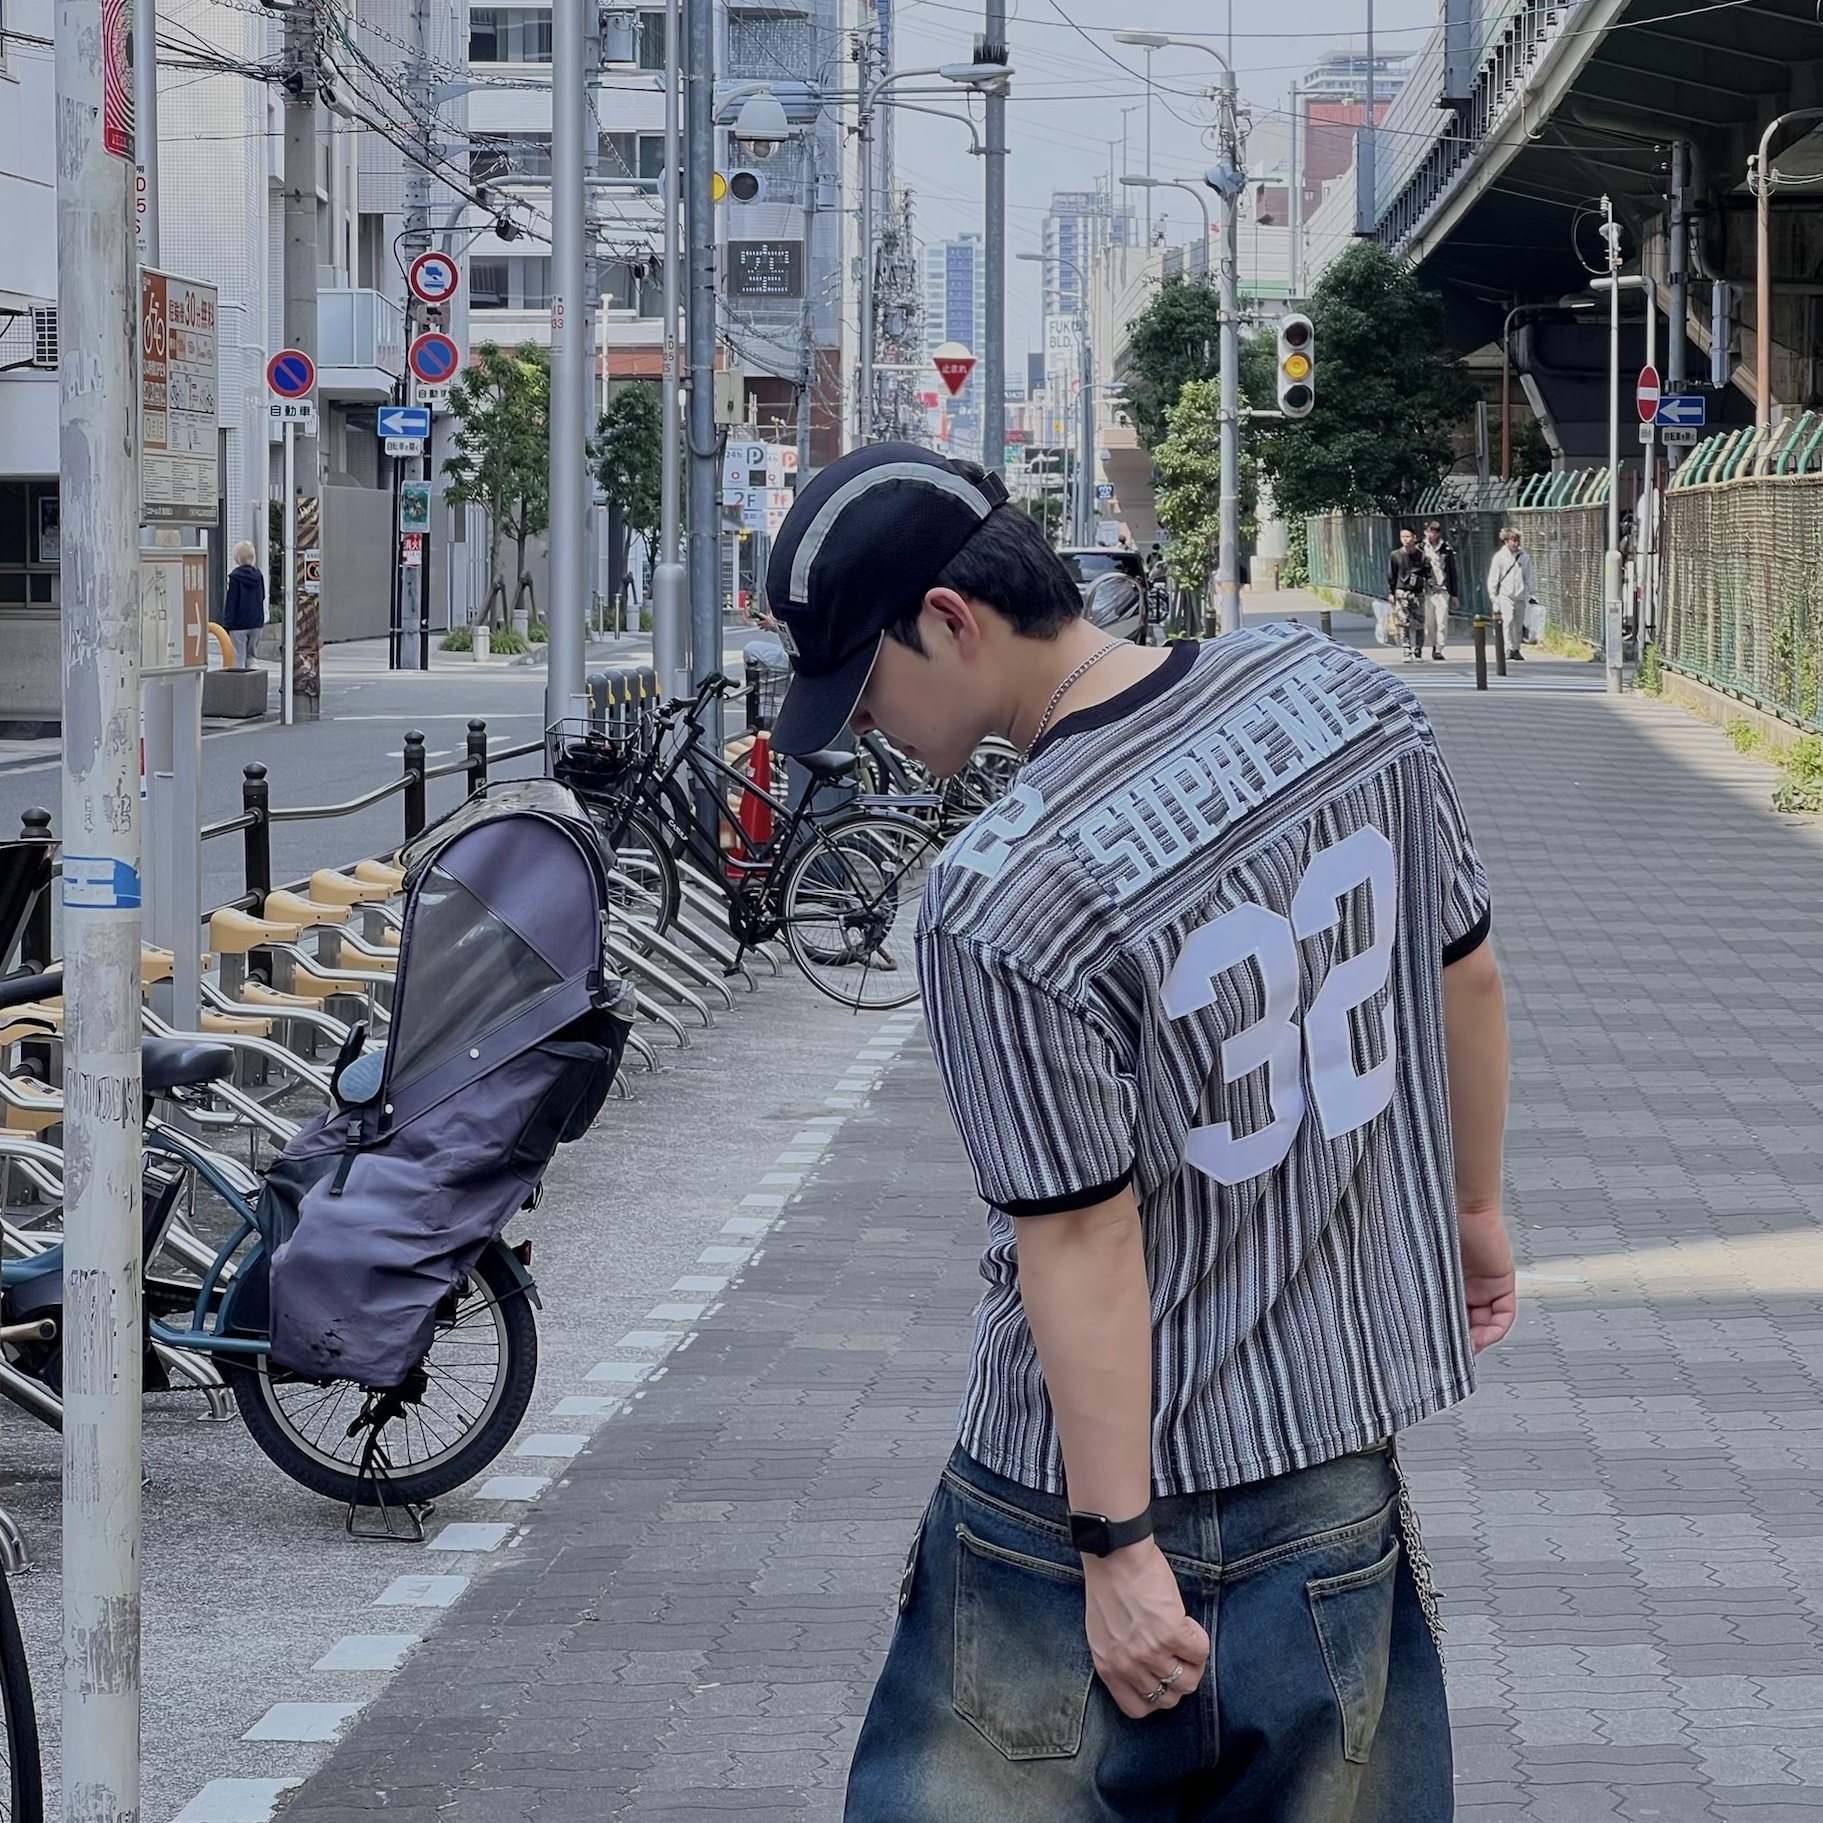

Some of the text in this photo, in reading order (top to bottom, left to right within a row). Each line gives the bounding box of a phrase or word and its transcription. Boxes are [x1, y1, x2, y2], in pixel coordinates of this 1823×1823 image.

[740, 244, 790, 292] 空
[941, 364, 968, 375] 止まれ
[270, 405, 311, 417] 自動車
[1077, 655, 1378, 898] SUPREME
[1160, 822, 1398, 1187] 32
